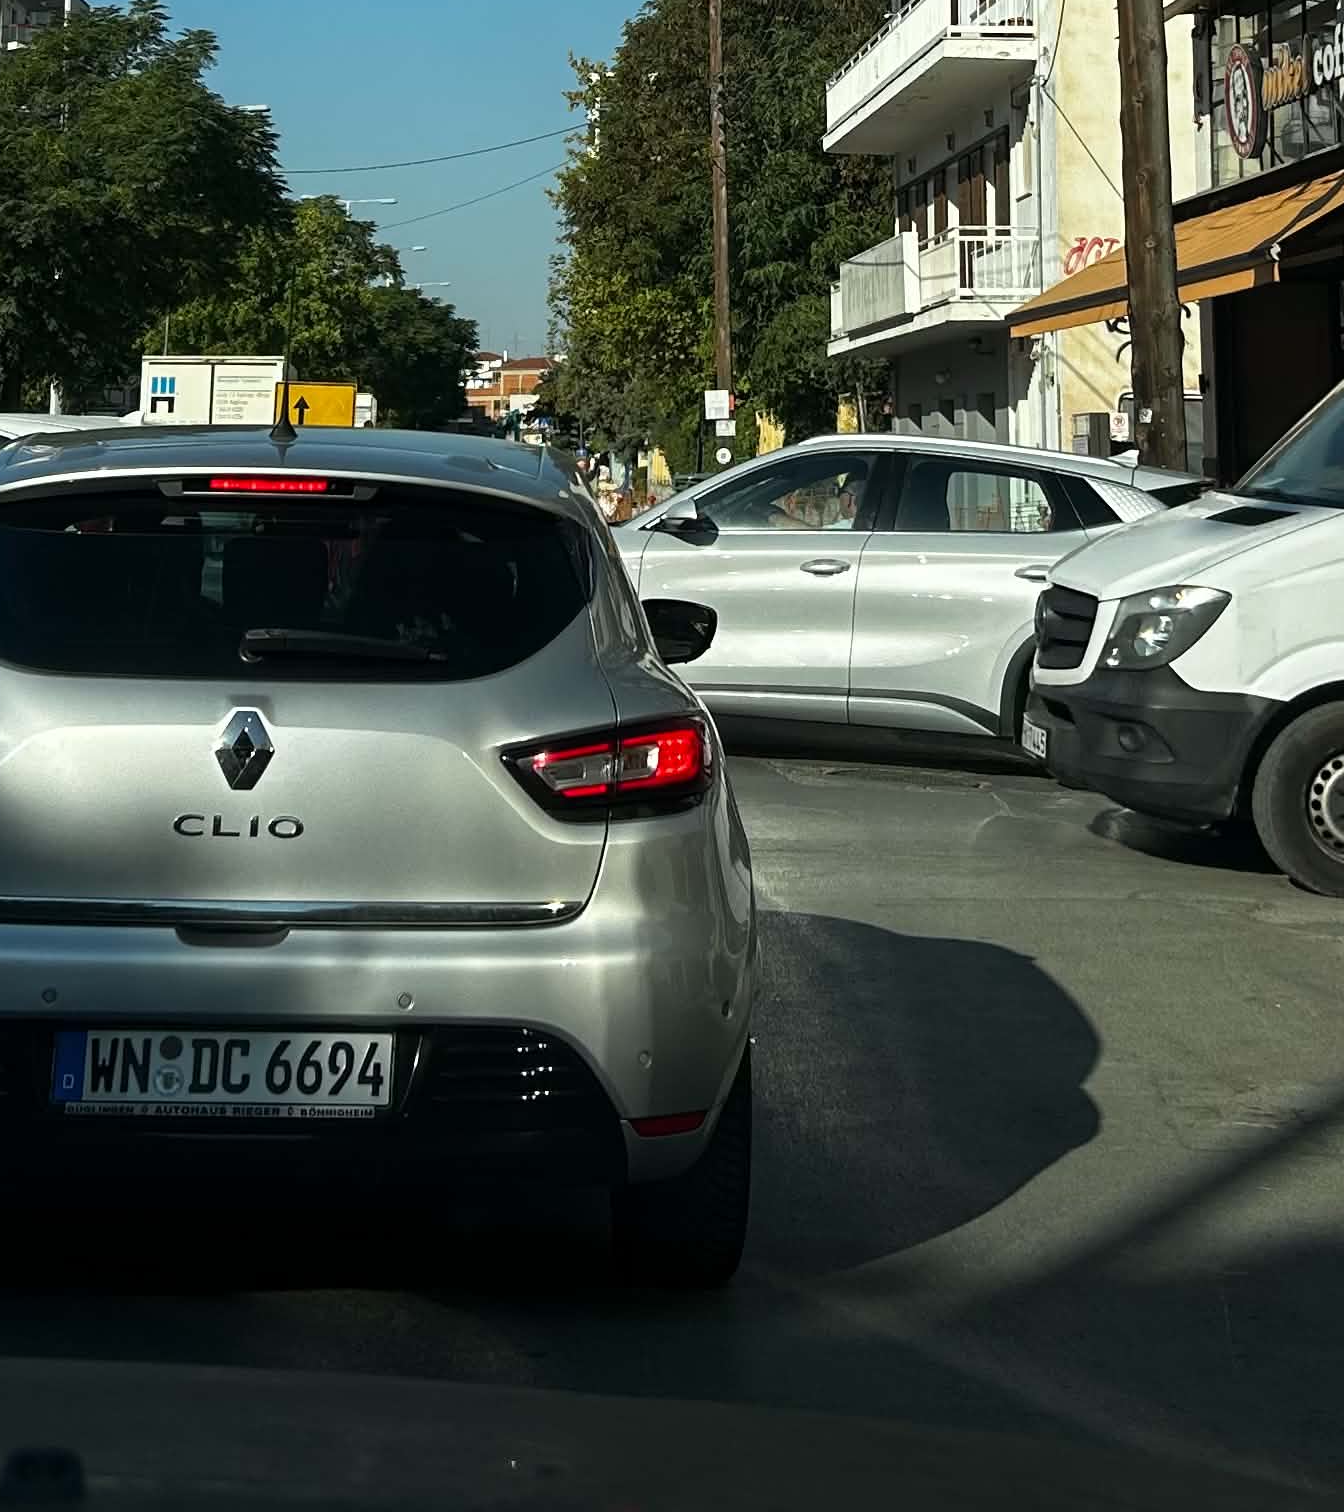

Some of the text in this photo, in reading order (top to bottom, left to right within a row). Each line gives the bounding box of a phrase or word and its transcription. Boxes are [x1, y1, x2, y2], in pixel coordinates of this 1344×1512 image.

[172, 813, 305, 839] CLIO
[90, 1037, 152, 1095] WN
[188, 1039, 251, 1095] DC
[264, 1040, 385, 1098] 6694
